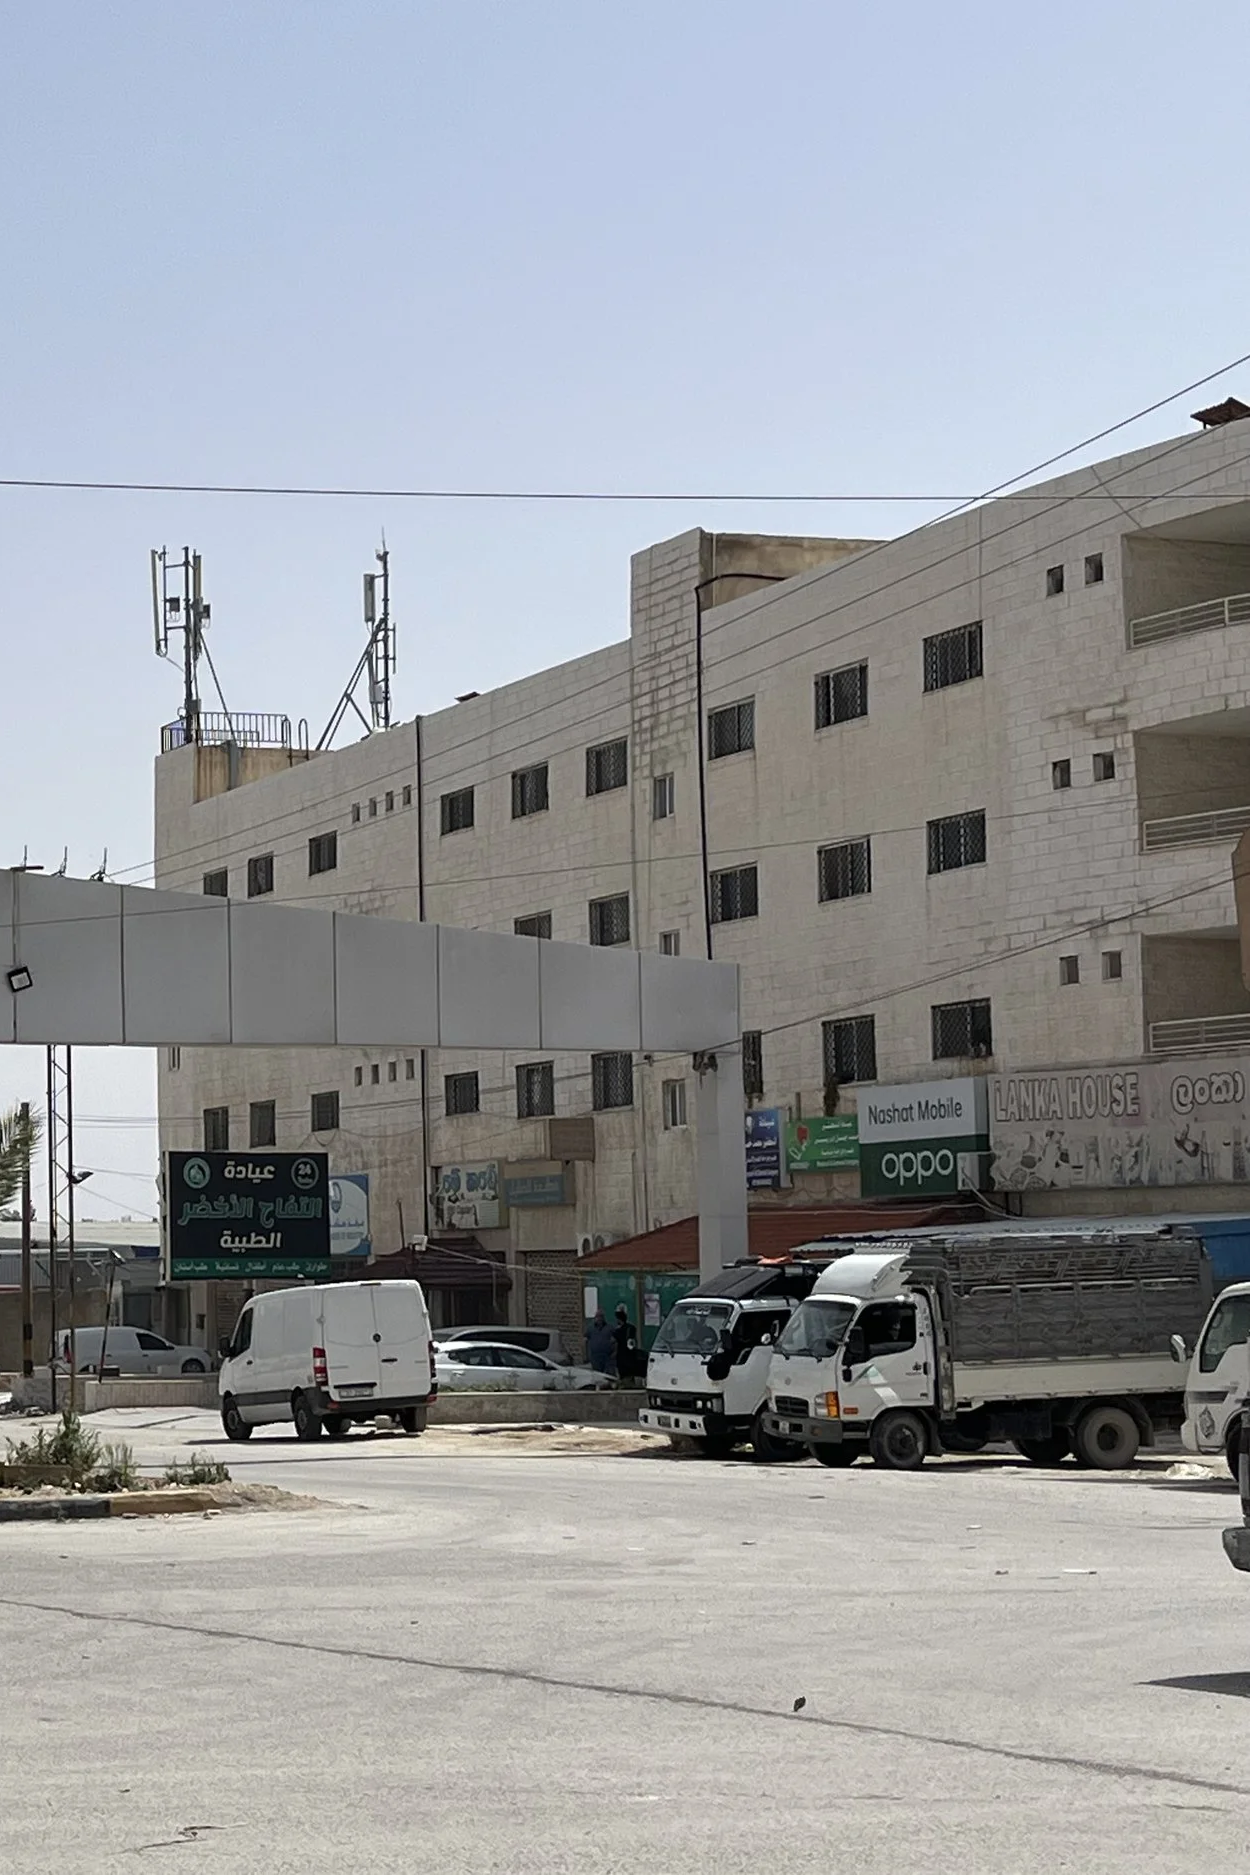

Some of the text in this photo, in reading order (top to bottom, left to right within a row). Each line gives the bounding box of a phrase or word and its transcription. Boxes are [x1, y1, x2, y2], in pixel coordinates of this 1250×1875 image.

[868, 1101, 915, 1126] Nashat
[917, 1097, 963, 1121] Mobile
[994, 1072, 1141, 1122] LANKA HOUSE
[223, 1160, 276, 1184] عيادة
[297, 1163, 312, 1175] 24
[881, 1147, 955, 1186] oppo
[177, 1193, 323, 1229] التفاح الأخضر
[219, 1230, 283, 1254] الطبية
